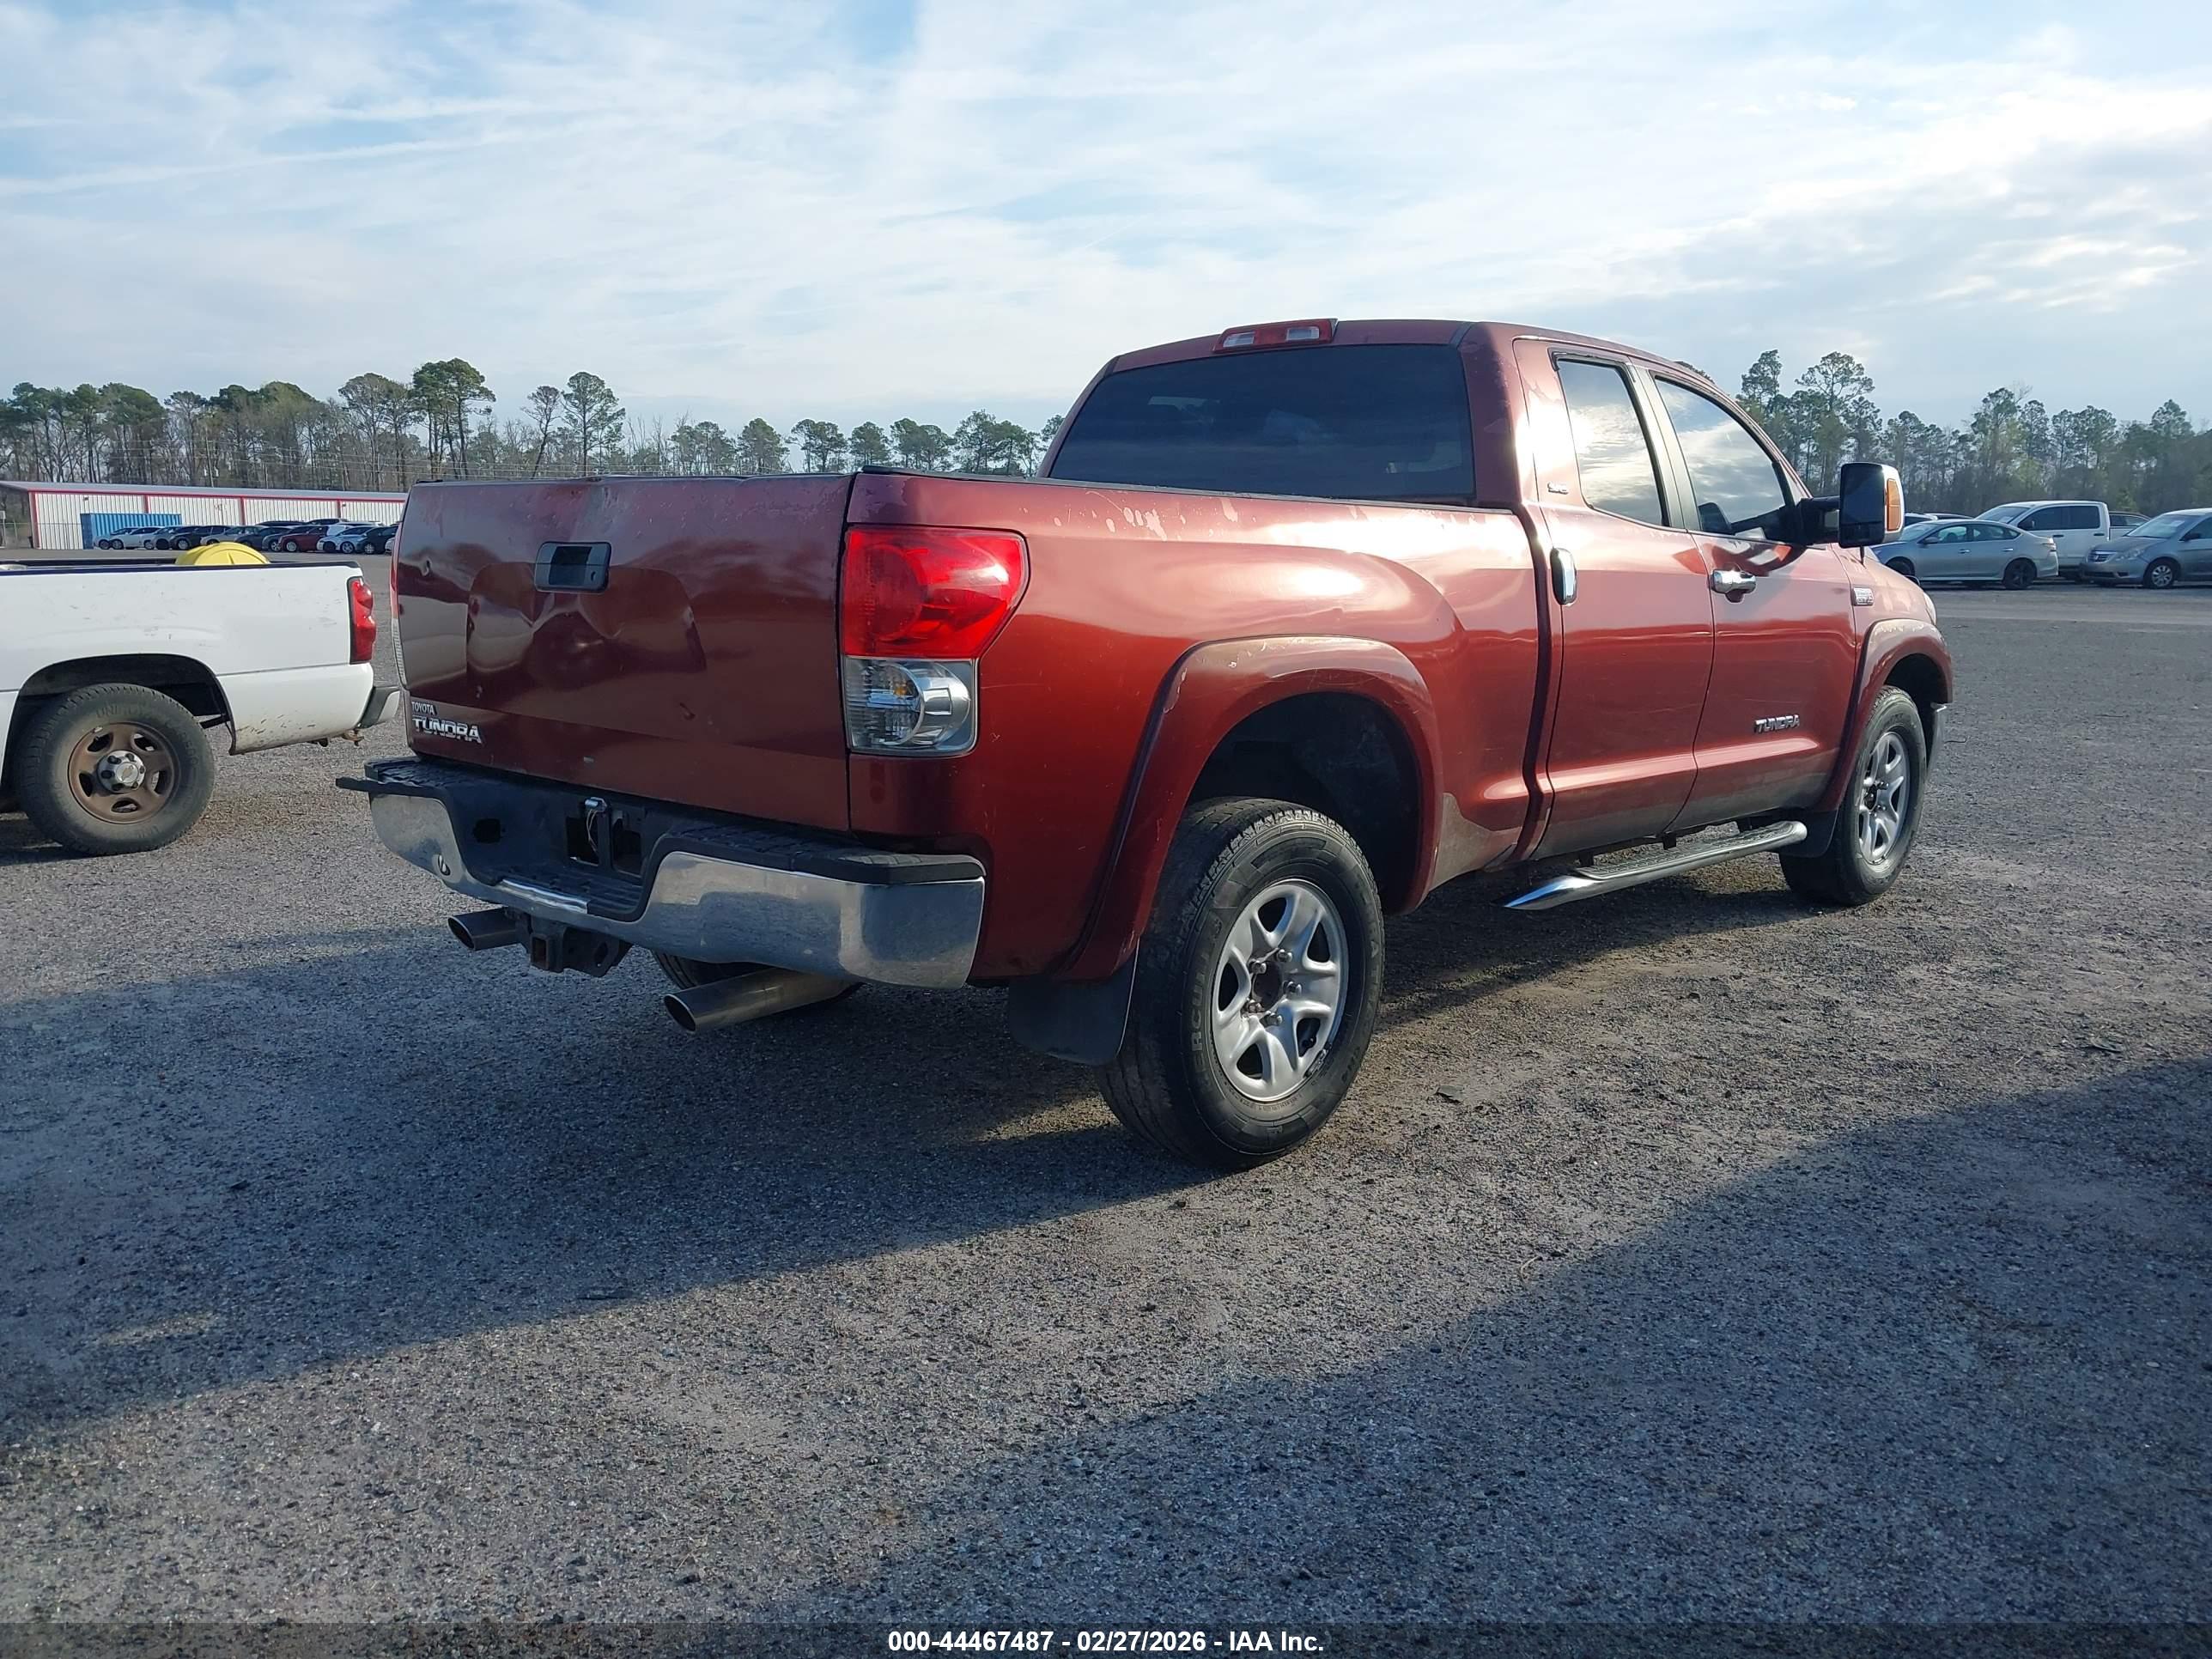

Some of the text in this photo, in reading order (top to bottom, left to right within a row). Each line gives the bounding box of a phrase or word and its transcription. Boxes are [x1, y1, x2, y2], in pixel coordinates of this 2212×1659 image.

[411, 702, 435, 715] TOYOTA
[412, 715, 483, 744] TUNDRA
[1754, 714, 1801, 733] TUNDRA
